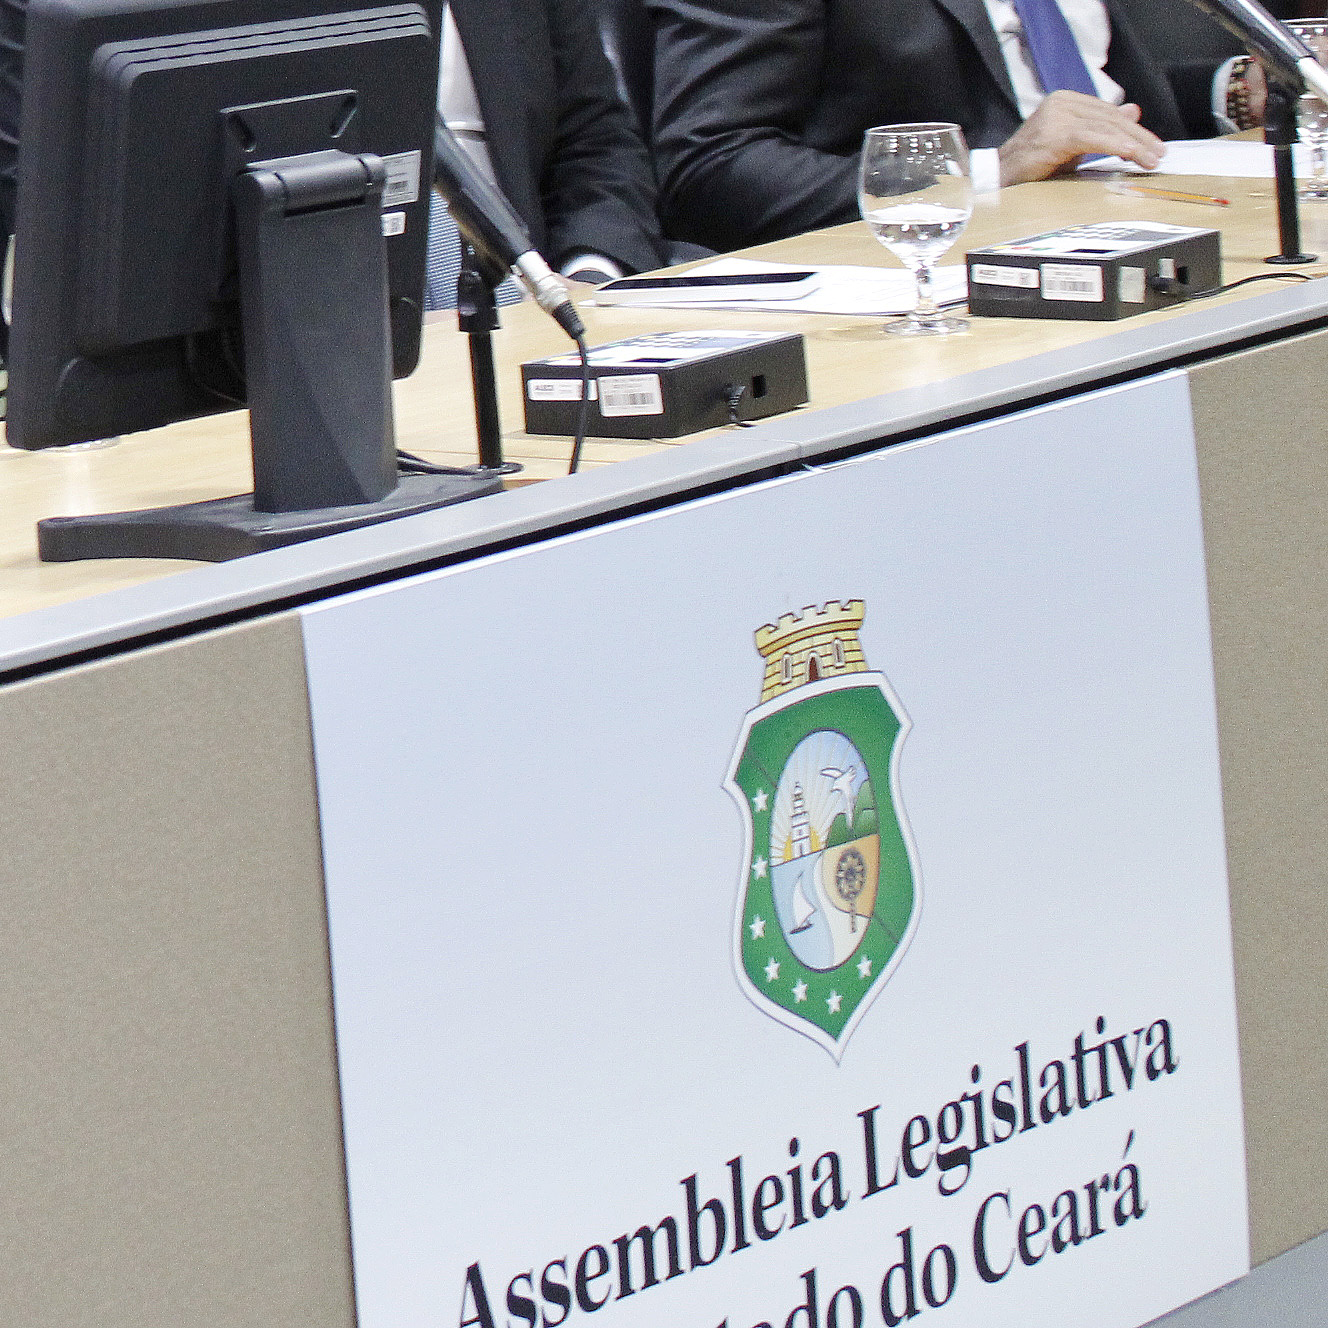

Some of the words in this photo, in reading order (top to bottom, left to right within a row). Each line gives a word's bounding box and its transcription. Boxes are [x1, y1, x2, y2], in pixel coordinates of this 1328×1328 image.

[458, 1136, 851, 1328] Assembleia
[856, 1015, 1180, 1197] Legislativa
[880, 1226, 958, 1328] do
[972, 1128, 1149, 1284] Ceará
